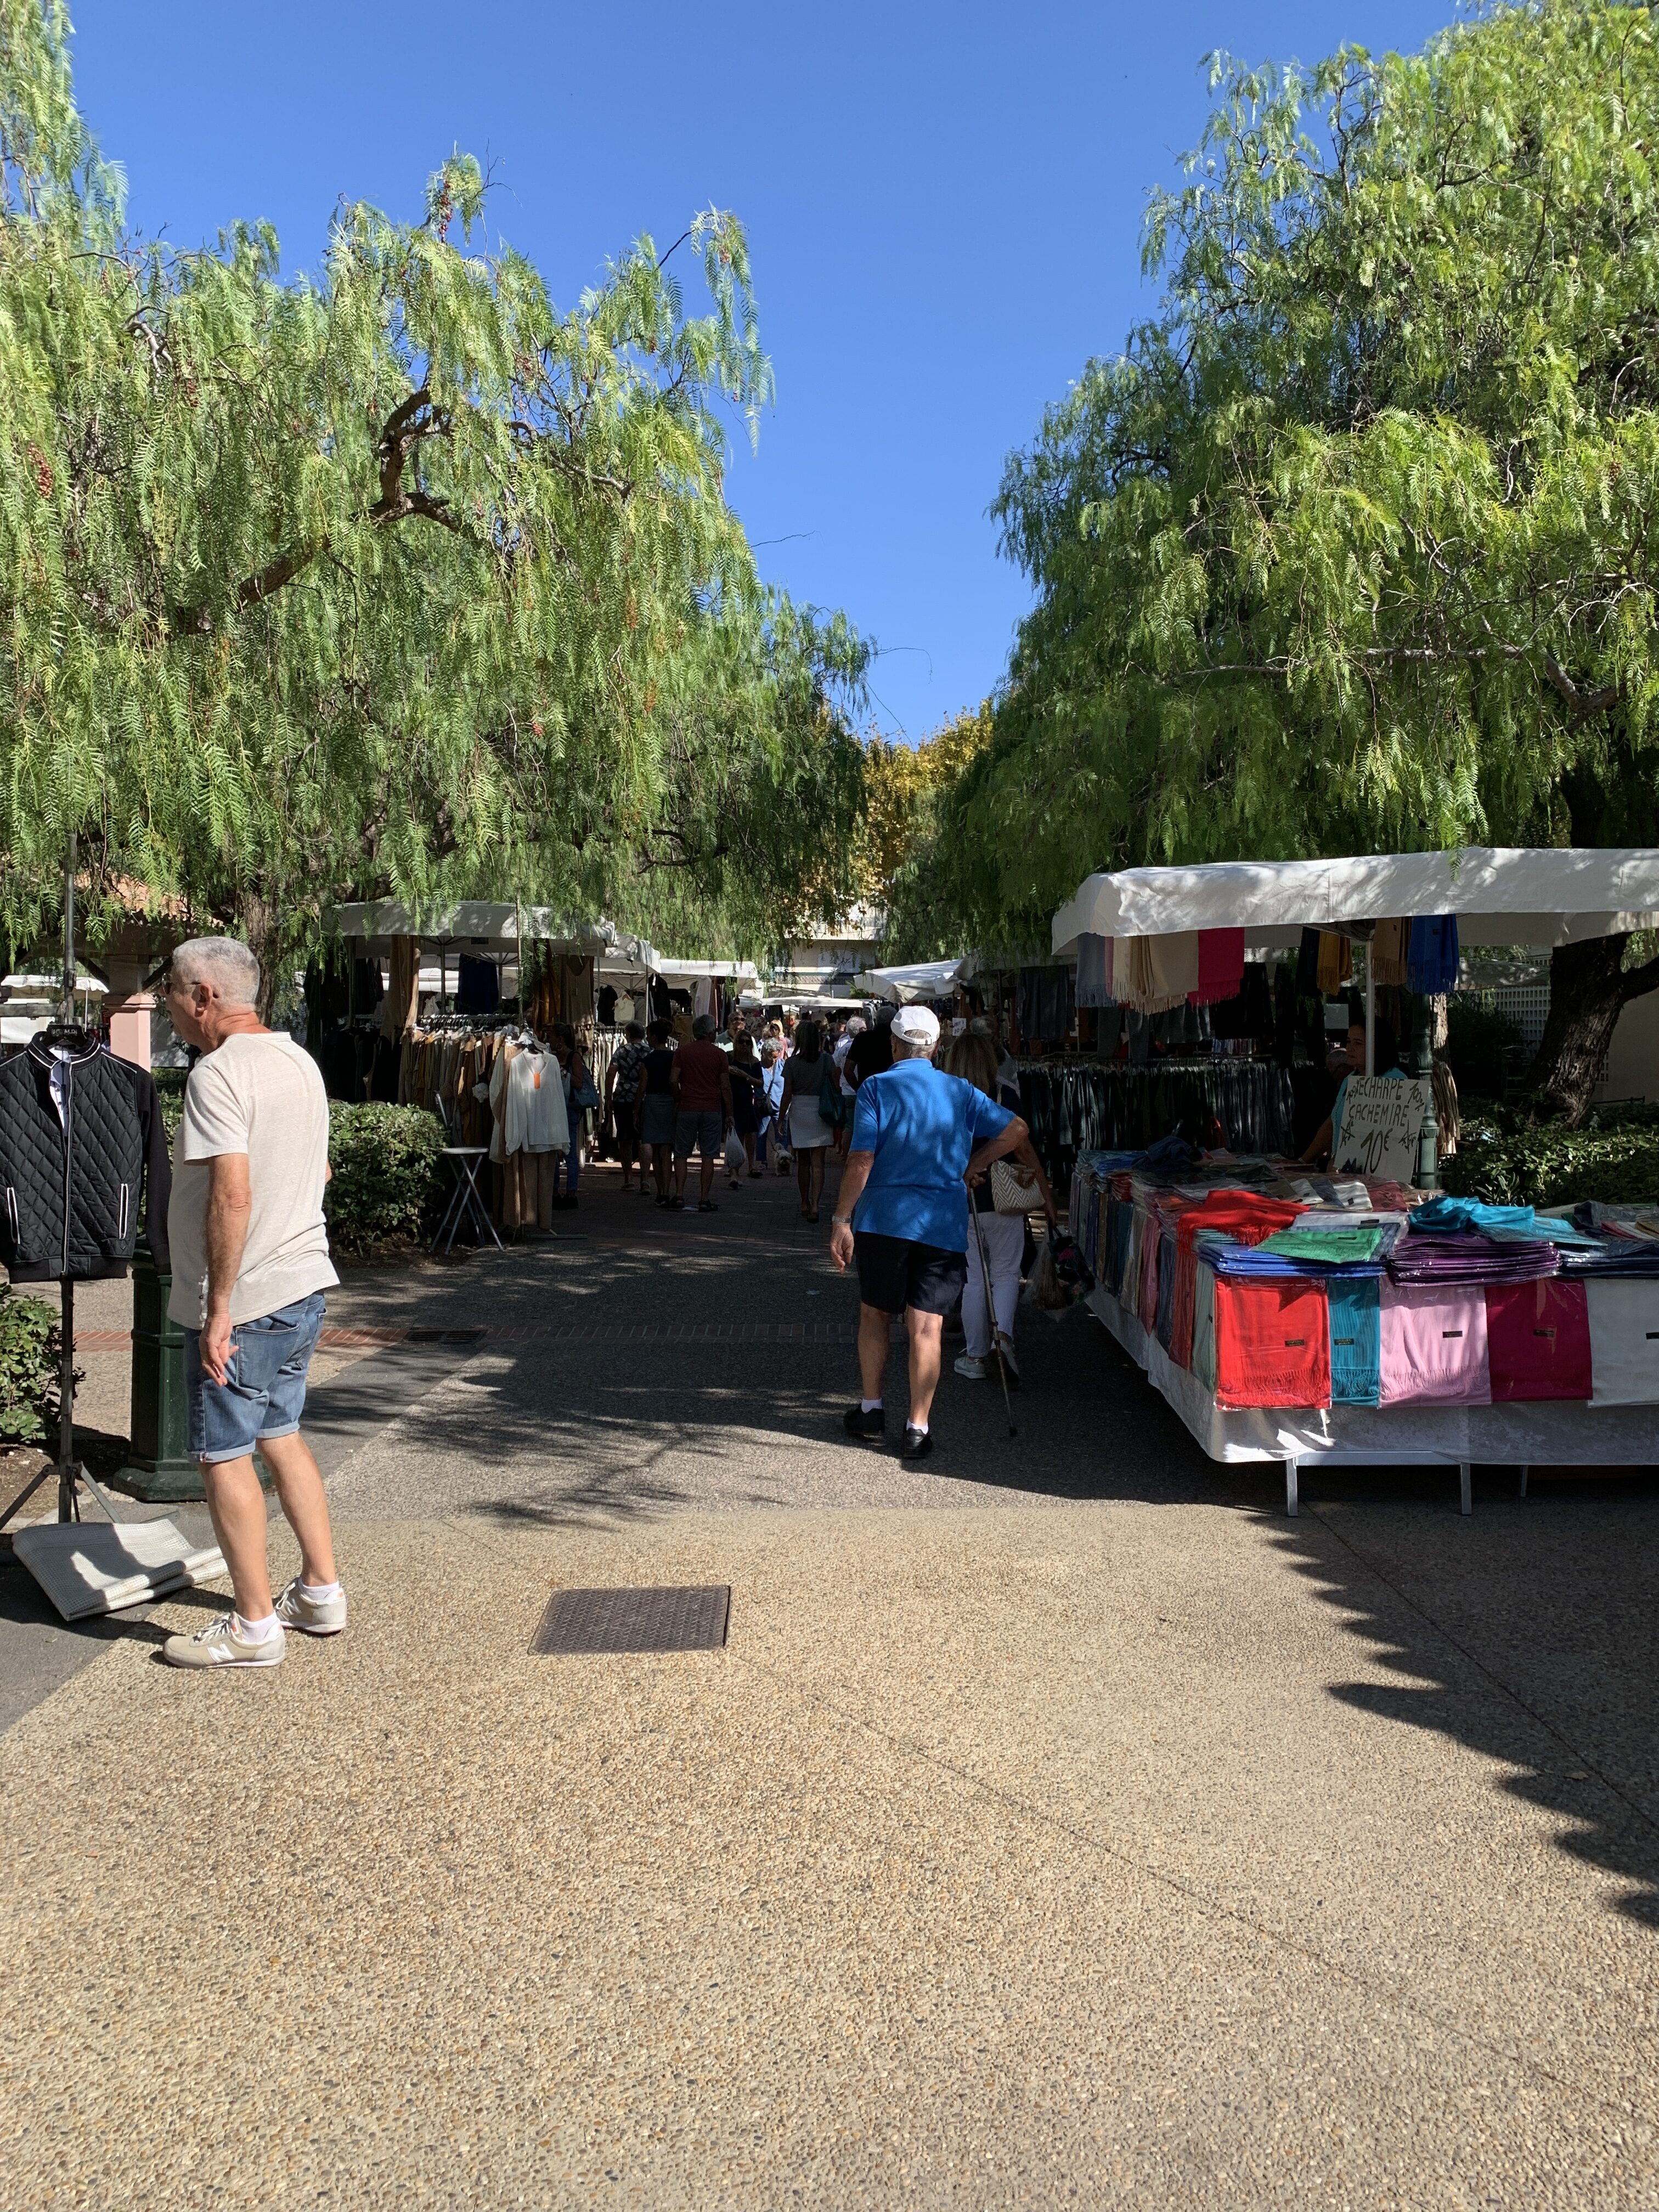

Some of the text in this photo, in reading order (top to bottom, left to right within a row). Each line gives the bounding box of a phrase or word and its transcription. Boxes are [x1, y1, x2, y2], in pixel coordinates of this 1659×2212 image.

[1359, 1077, 1404, 1100] ECHARPE
[1349, 1103, 1409, 1126] CACHEMIRE
[207, 1644, 235, 1663] N
